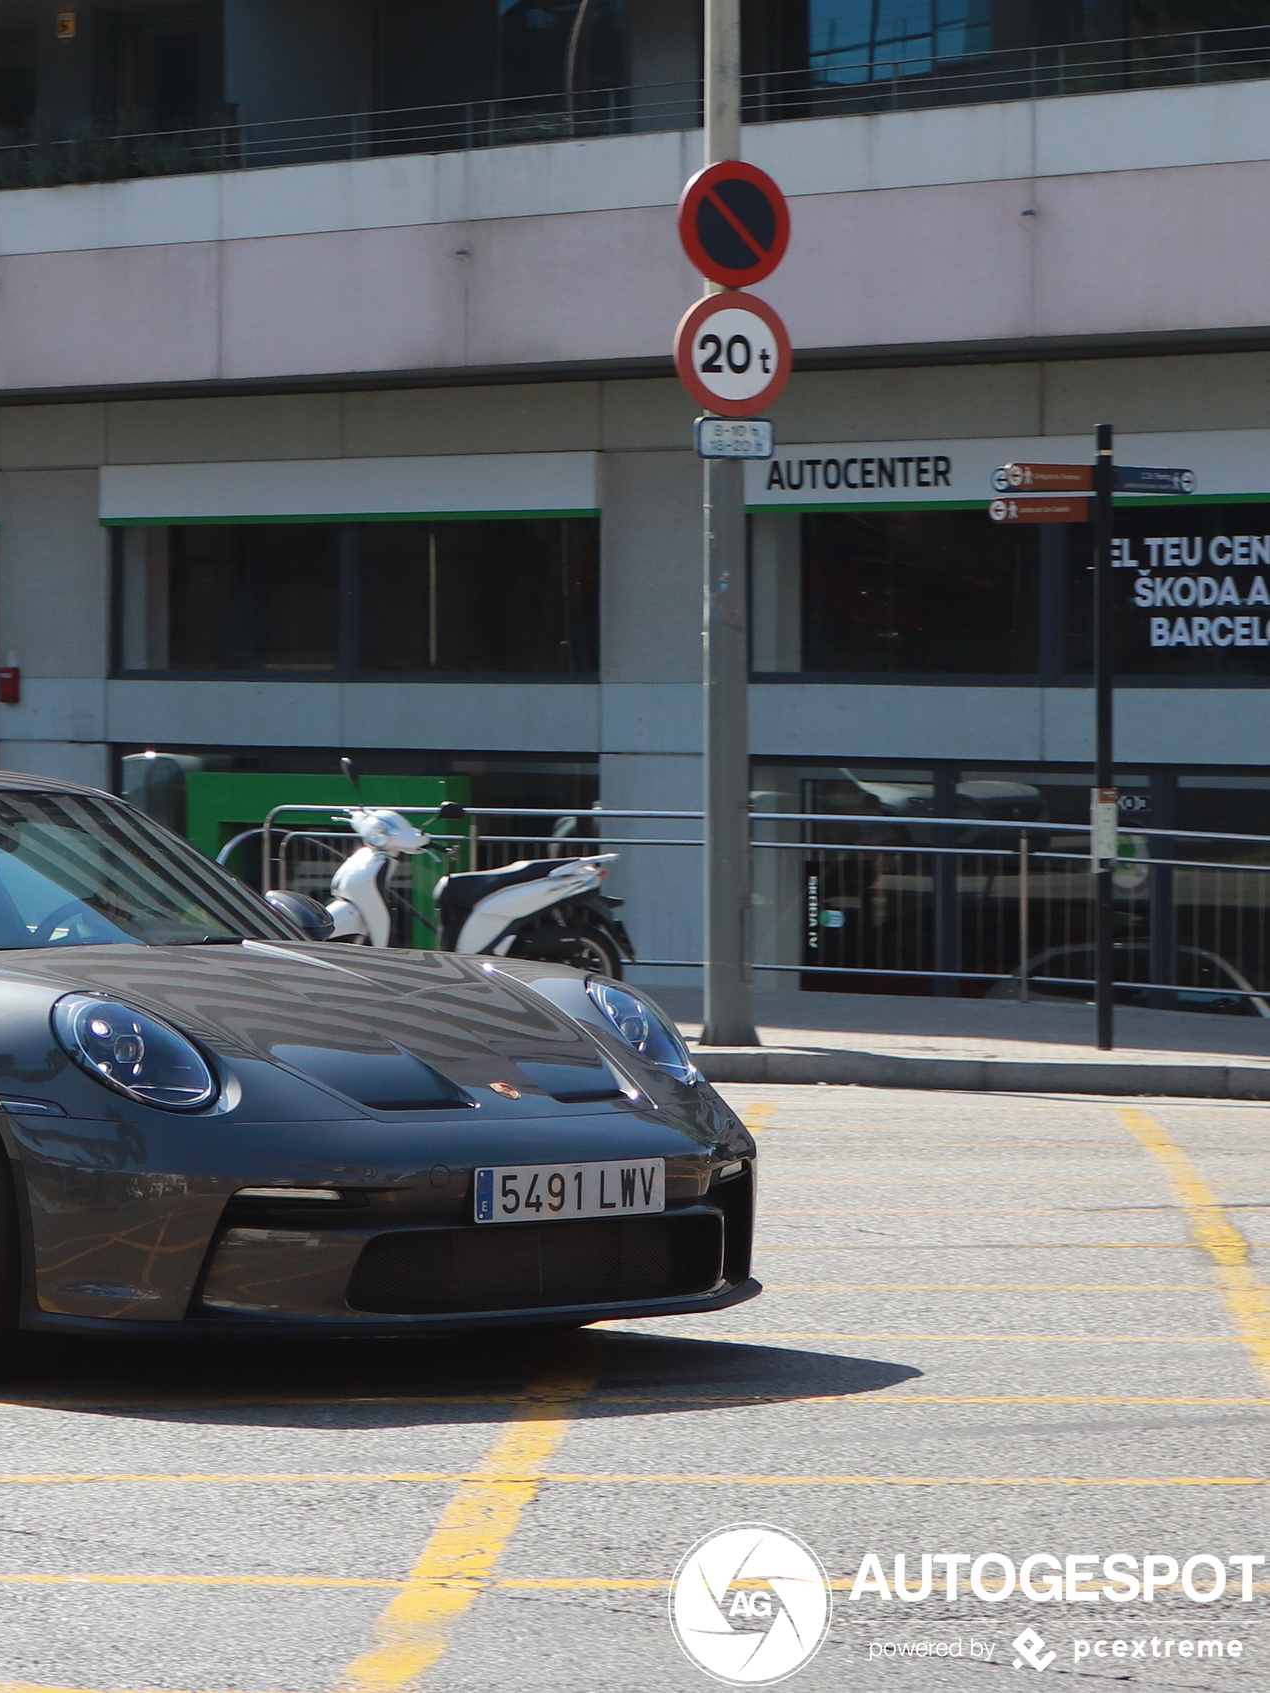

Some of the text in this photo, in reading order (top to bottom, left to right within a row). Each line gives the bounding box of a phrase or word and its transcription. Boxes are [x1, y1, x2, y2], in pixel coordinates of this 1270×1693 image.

[699, 333, 772, 374] 20 t
[766, 456, 951, 490] AUTOCENTER
[1143, 537, 1203, 567] TEU
[1134, 569, 1241, 608] ŠKODA
[1150, 616, 1270, 647] BARCEL
[481, 1200, 489, 1213] E
[501, 1166, 656, 1214] 5491 LWV
